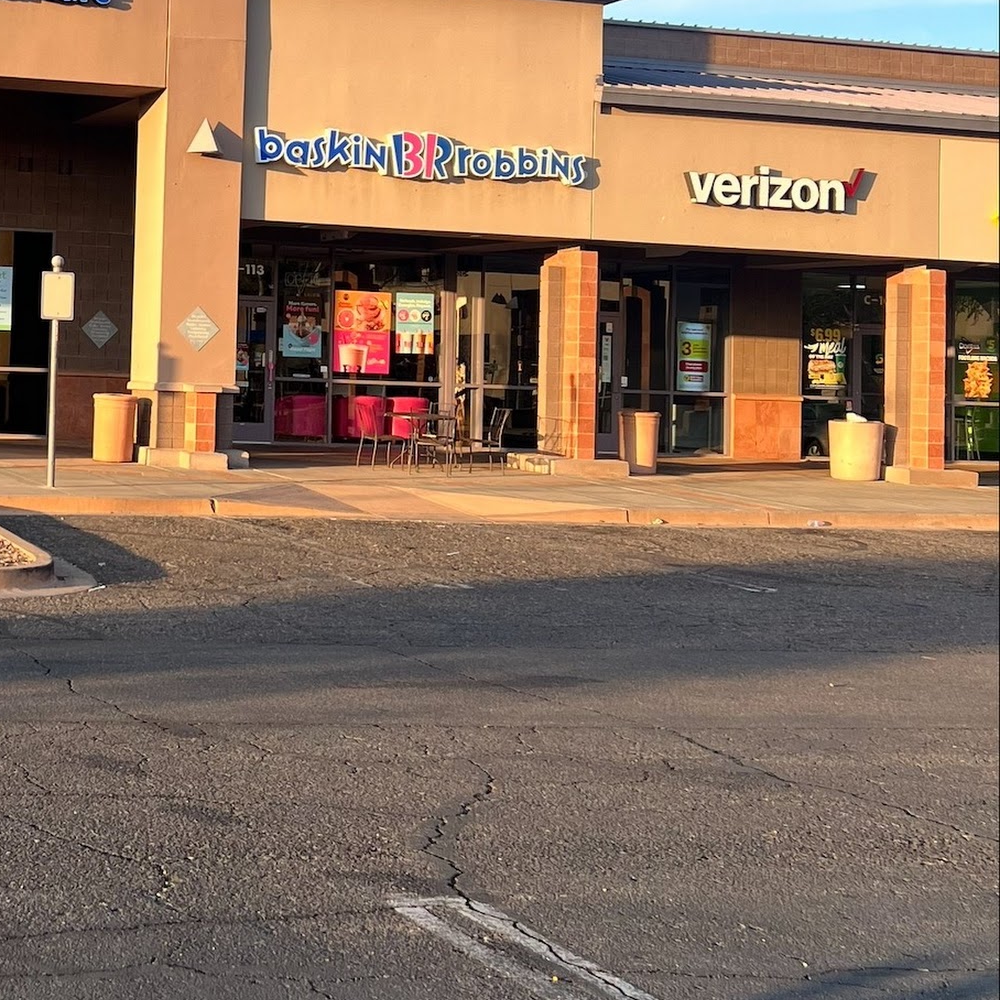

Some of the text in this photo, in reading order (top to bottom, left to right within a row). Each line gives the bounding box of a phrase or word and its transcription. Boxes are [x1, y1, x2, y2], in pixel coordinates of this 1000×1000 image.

[254, 126, 389, 176] baskin
[452, 143, 587, 187] robbins
[686, 165, 847, 212] verizon
[238, 264, 265, 275] -113
[810, 327, 841, 342] $6.99
[681, 341, 692, 356] 3
[818, 337, 847, 357] meal
